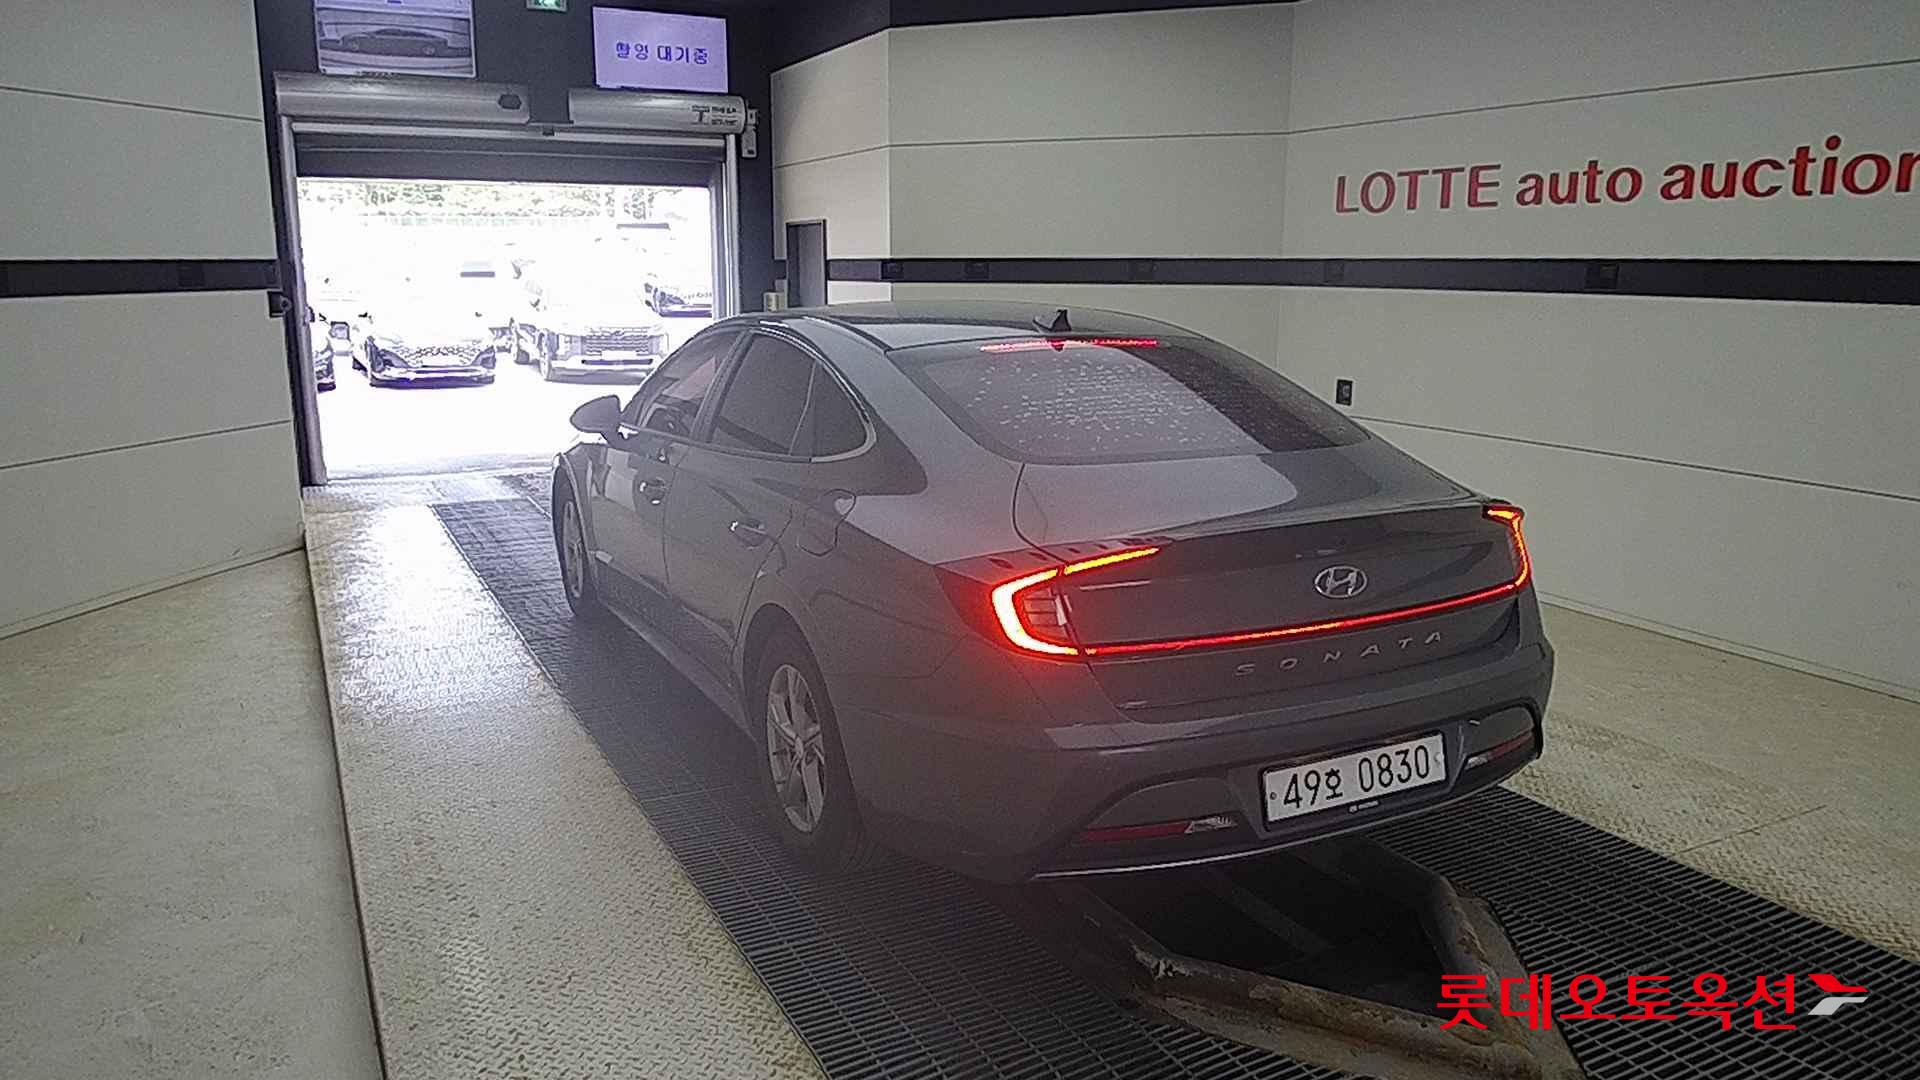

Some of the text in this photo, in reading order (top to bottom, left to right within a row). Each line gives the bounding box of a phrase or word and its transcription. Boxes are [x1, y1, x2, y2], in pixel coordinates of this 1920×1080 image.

[657, 45, 708, 65] 대기중
[1336, 164, 1501, 213] LOTTE
[1516, 160, 1642, 206] auto
[1235, 631, 1441, 676] SONATA
[1284, 745, 1429, 808] 49호 0830
